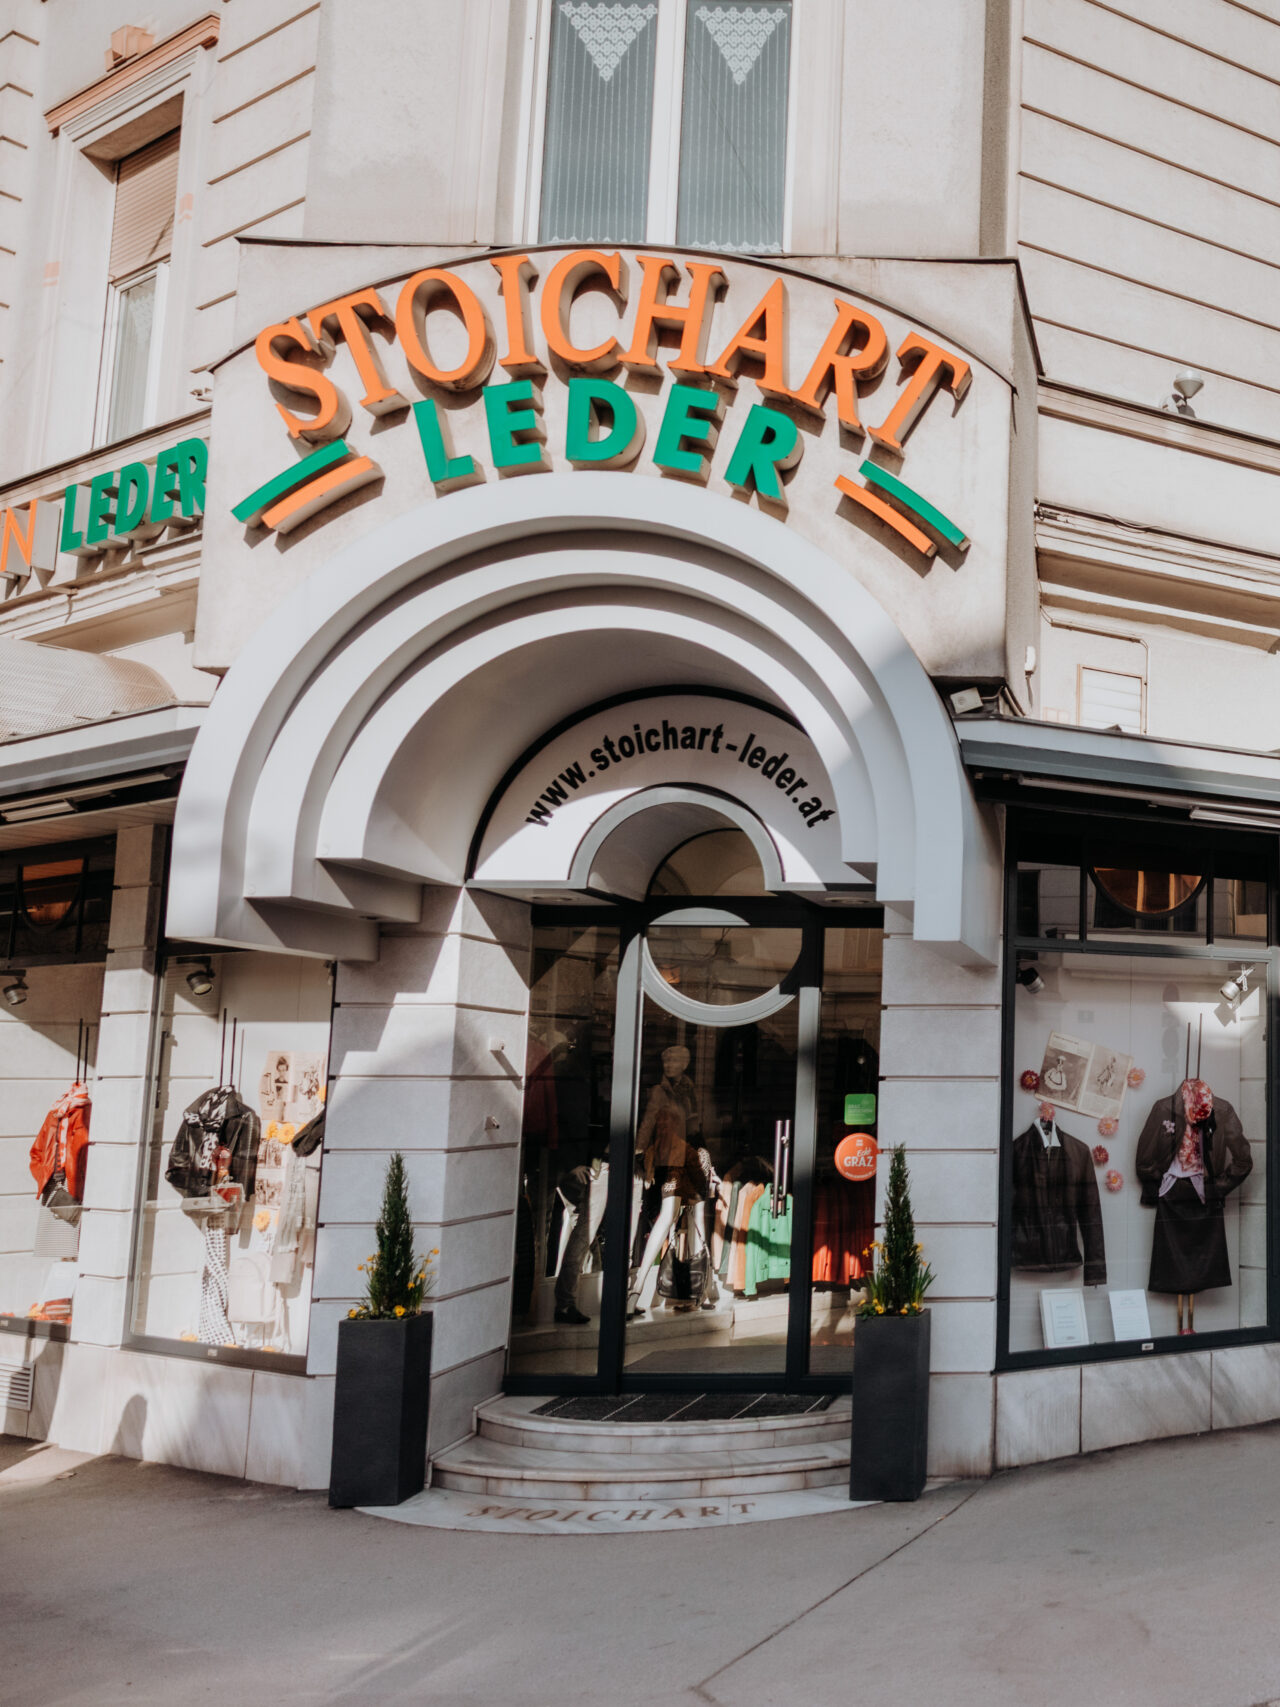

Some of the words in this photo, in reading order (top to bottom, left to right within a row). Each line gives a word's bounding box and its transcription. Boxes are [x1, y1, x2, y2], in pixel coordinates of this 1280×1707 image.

[255, 250, 971, 452] STOICHART
[413, 378, 798, 498] LEDER
[0, 499, 38, 572] N
[60, 437, 209, 553] LEDER
[525, 719, 836, 828] www.stoichart-leder.at
[843, 1155, 875, 1168] GRAZ
[465, 1502, 756, 1522] STOICHART
